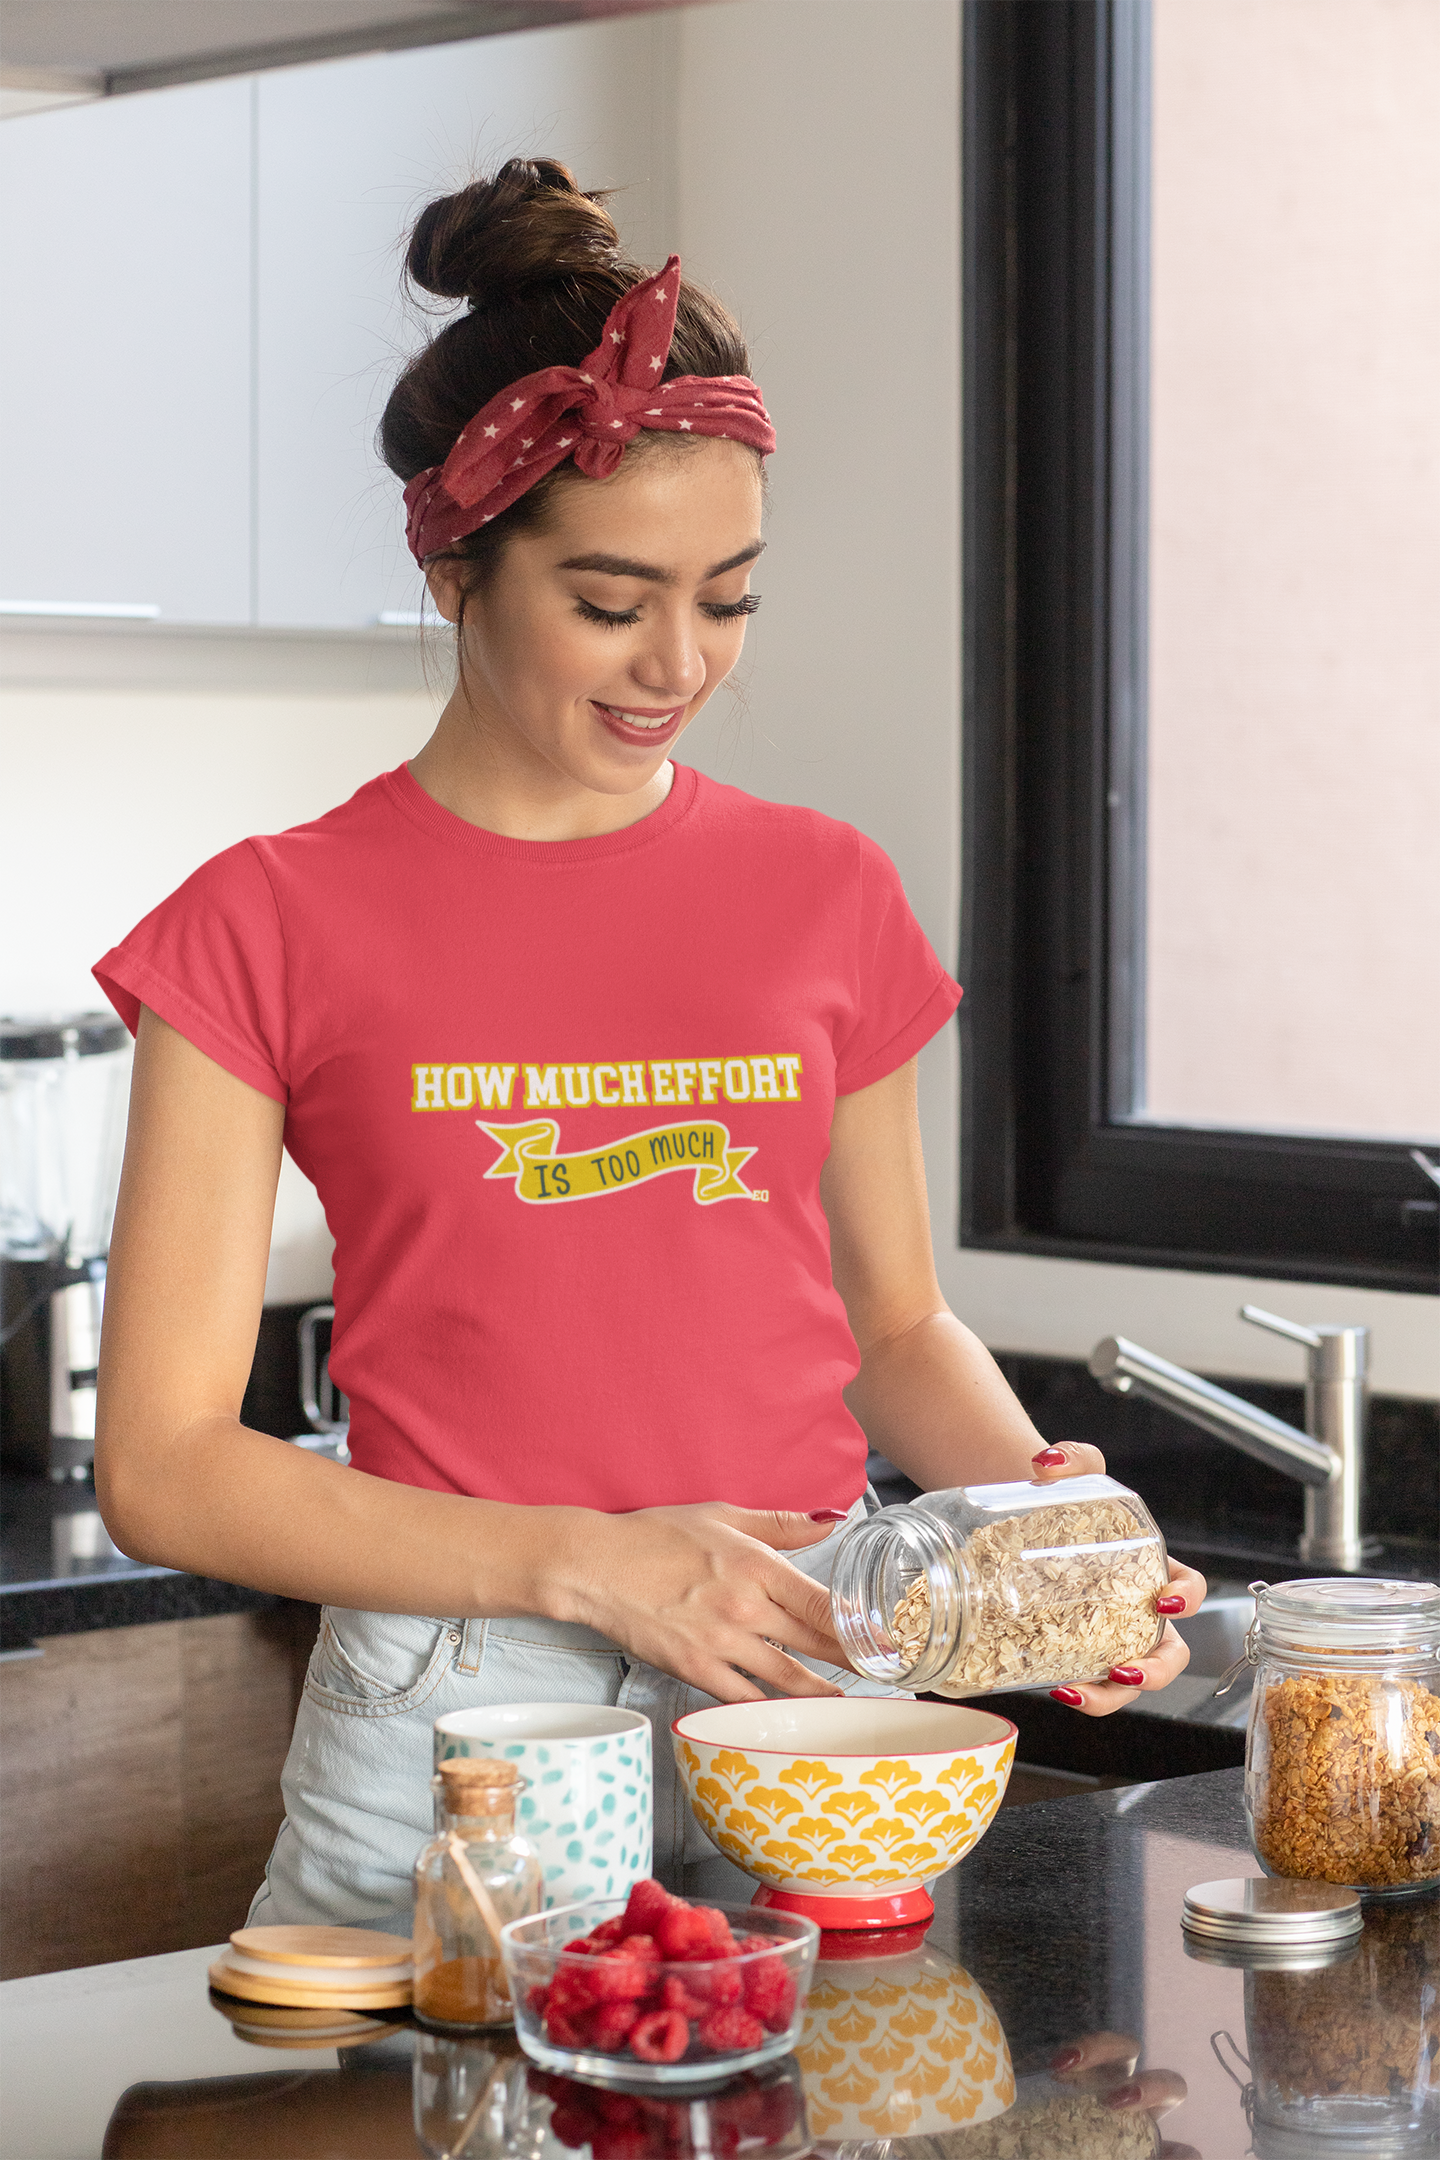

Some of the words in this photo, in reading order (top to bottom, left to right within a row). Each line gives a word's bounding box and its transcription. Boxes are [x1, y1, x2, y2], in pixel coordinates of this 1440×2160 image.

[412, 1063, 518, 1111] HOW
[523, 1061, 650, 1108] MUCH
[649, 1054, 802, 1105] EFFORT
[534, 1163, 571, 1198] IS
[590, 1150, 640, 1185] TOO
[649, 1131, 714, 1165] MUCH
